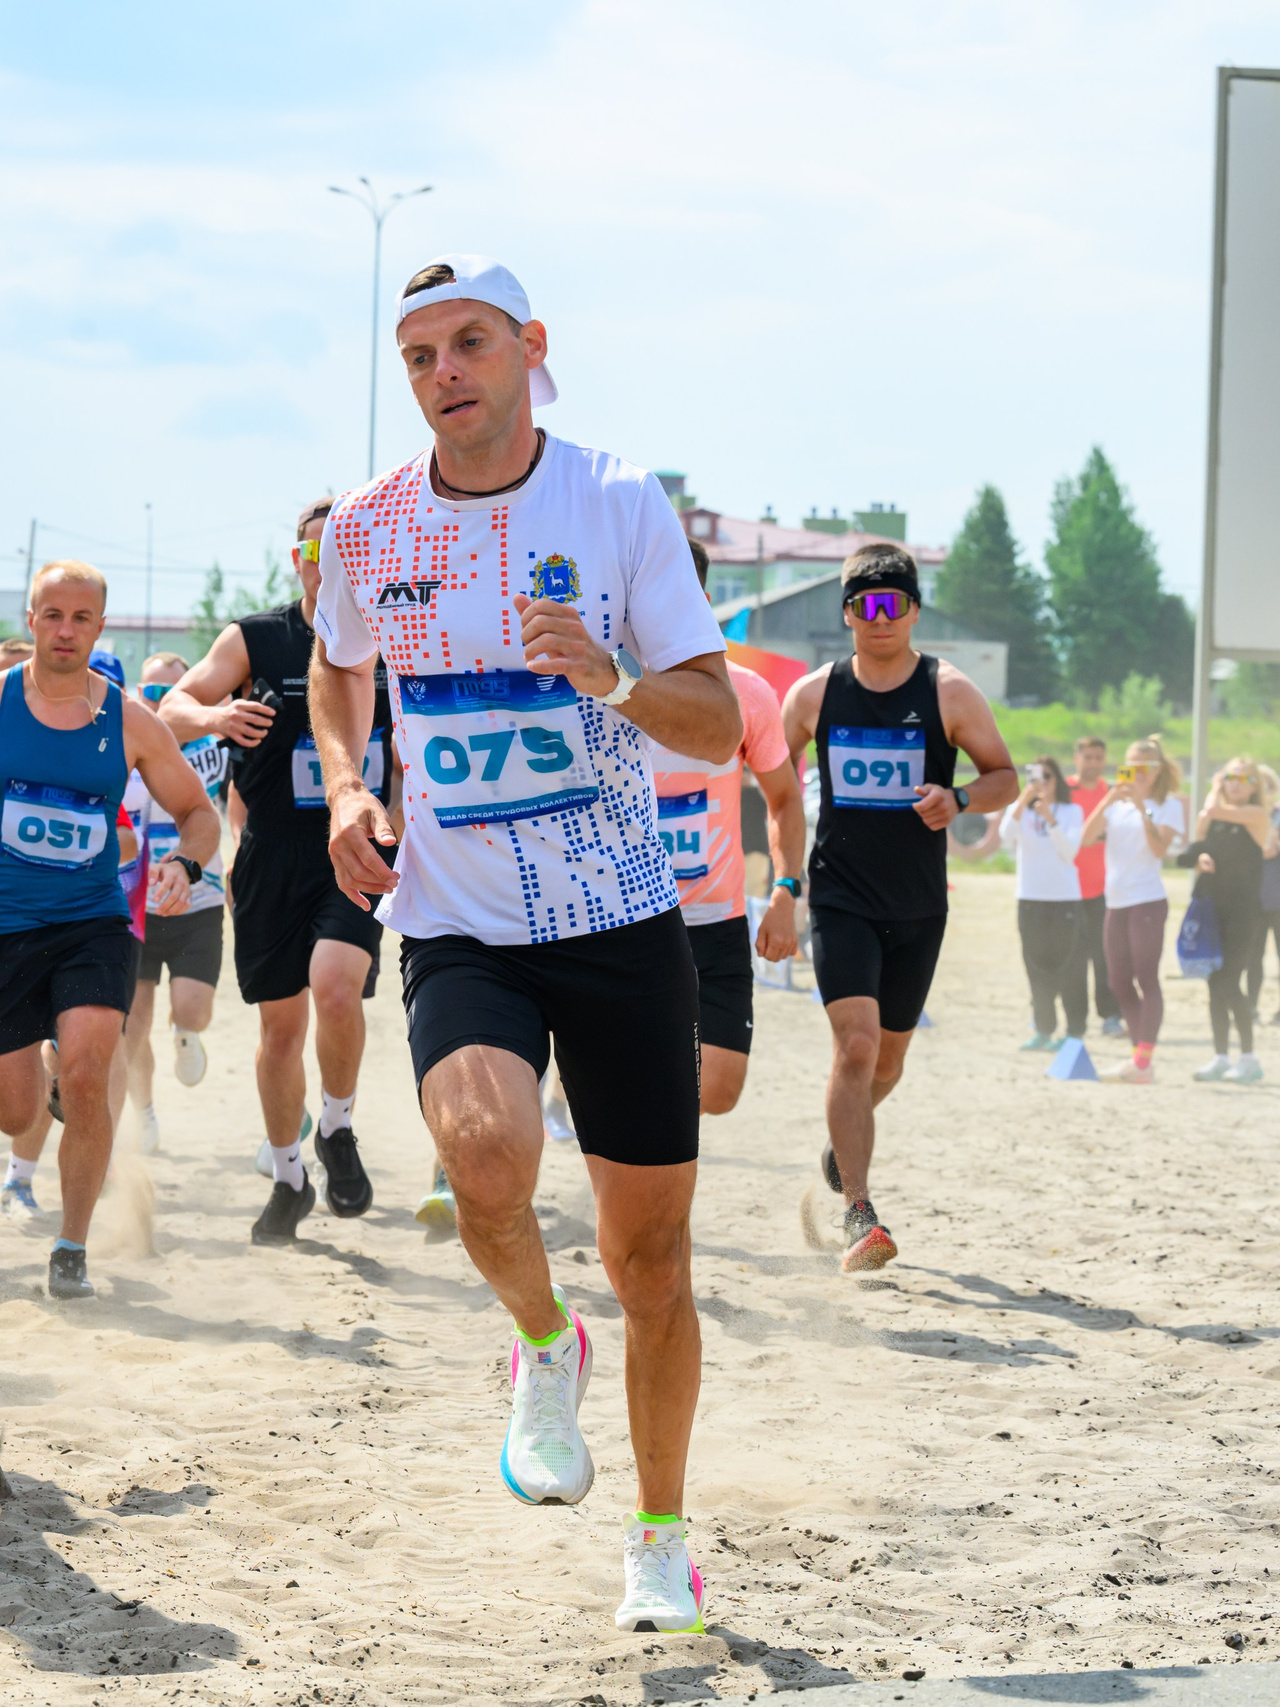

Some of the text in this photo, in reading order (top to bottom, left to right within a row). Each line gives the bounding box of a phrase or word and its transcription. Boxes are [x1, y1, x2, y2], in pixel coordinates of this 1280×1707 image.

[424, 726, 574, 785] 075
[842, 759, 910, 787] 091
[468, 811, 494, 819] СРЕДИ
[496, 805, 538, 817] ТРУДОВЫХ
[17, 816, 92, 850] 051
